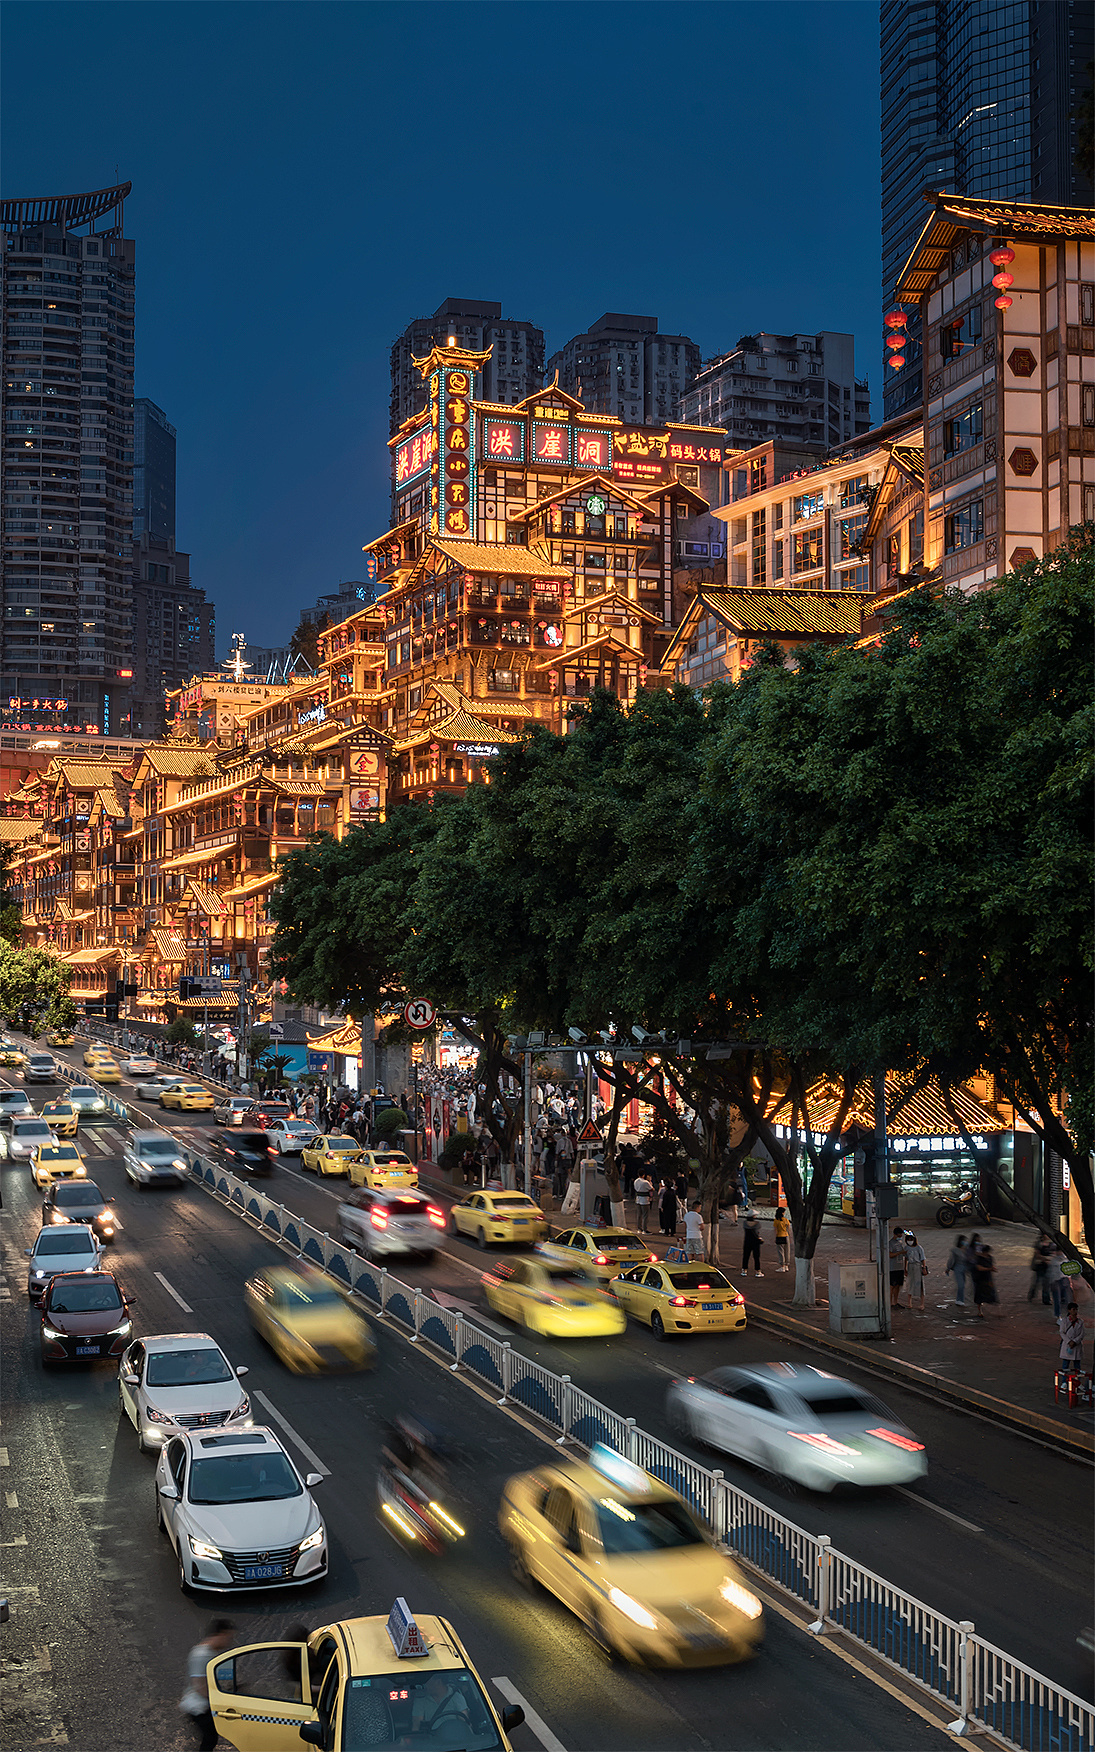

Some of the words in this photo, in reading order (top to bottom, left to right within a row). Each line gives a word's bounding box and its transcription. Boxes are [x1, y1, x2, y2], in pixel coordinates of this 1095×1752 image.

[490, 428, 602, 465] 洪崖洞
[671, 444, 721, 463] 码头火锅
[408, 1626, 418, 1646] 出租
[389, 1689, 409, 1700] 空车
